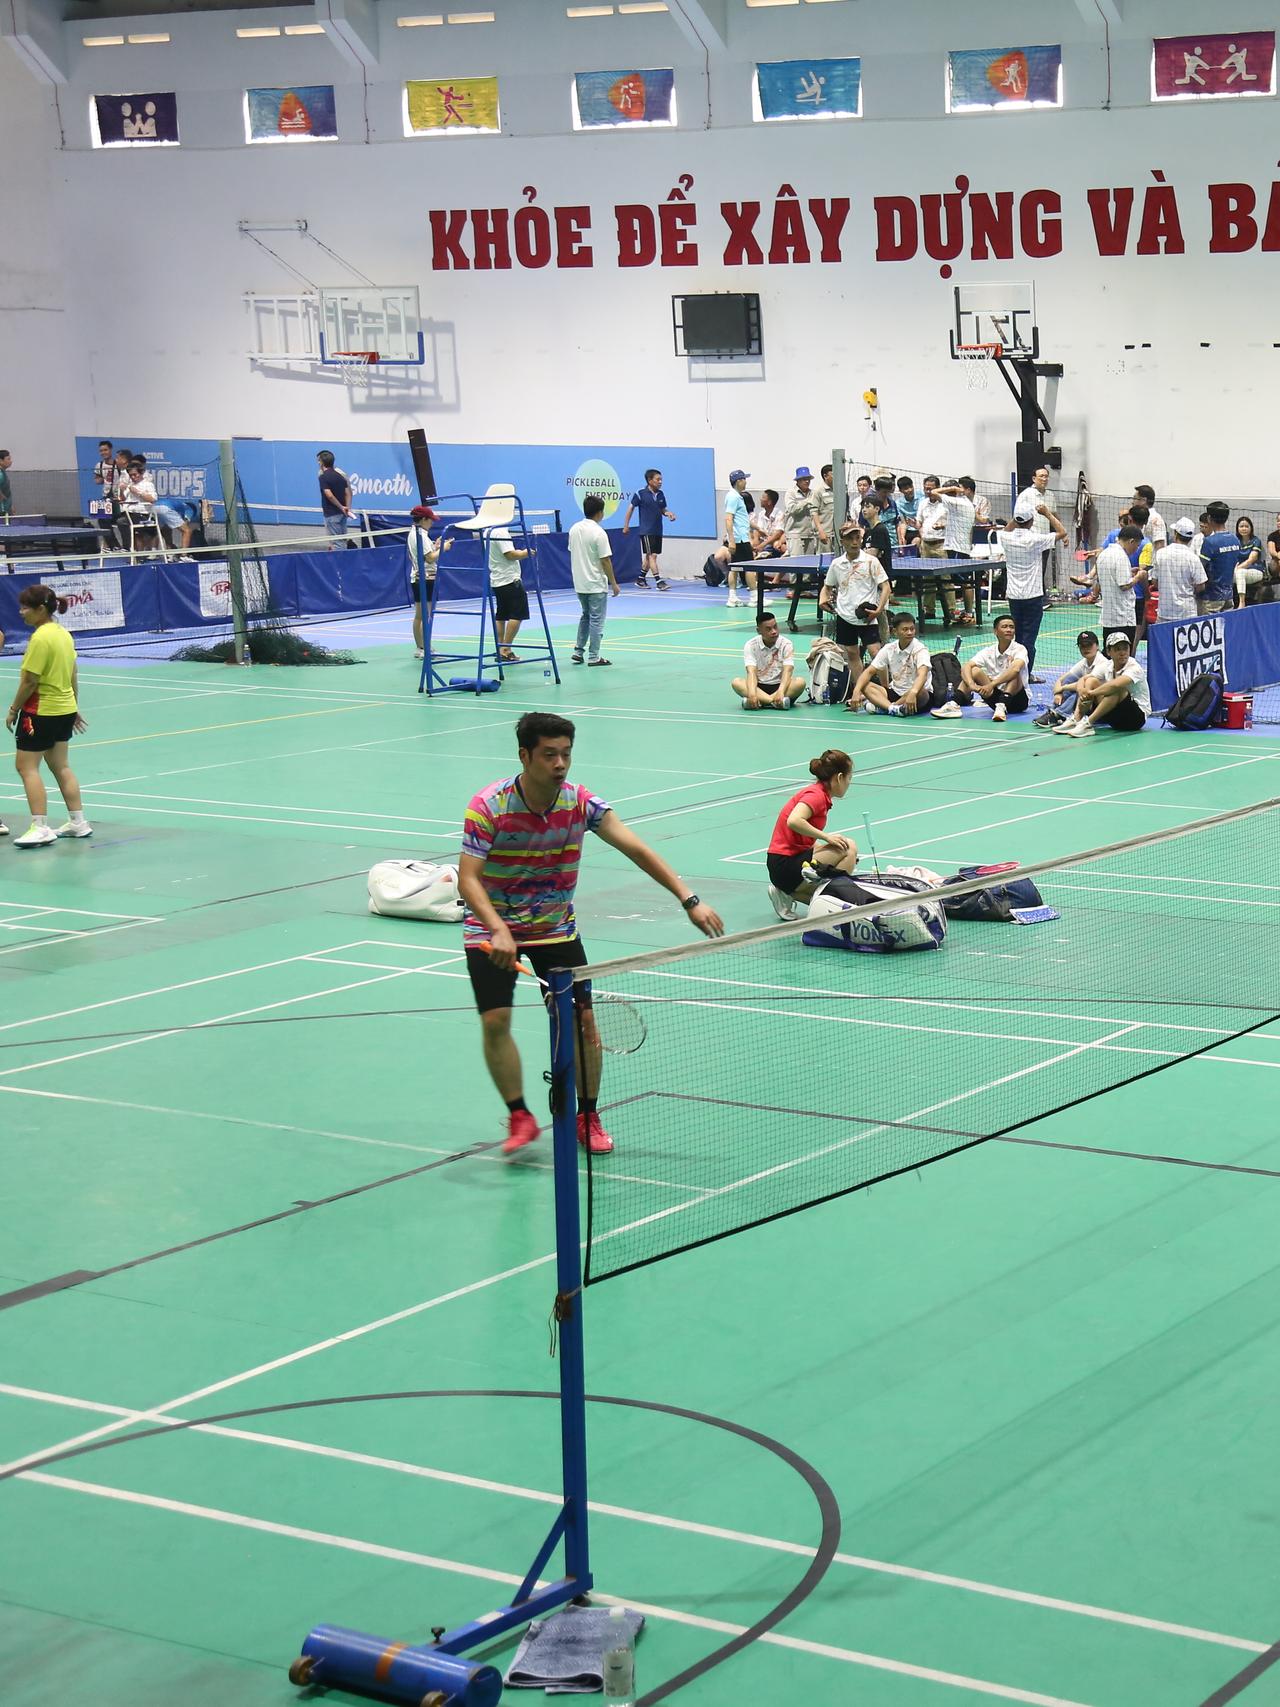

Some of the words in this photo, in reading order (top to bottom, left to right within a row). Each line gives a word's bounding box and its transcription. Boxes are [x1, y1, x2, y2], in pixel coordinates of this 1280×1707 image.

[428, 185, 594, 271] KHỎE
[614, 173, 699, 268] ĐỂ
[720, 183, 851, 266] XÂY
[874, 174, 1063, 279] DỰNG
[1087, 169, 1185, 257] VÀ
[349, 473, 413, 496] Smooth
[566, 478, 615, 487] PICKLEBALL
[1176, 618, 1223, 655] COOL
